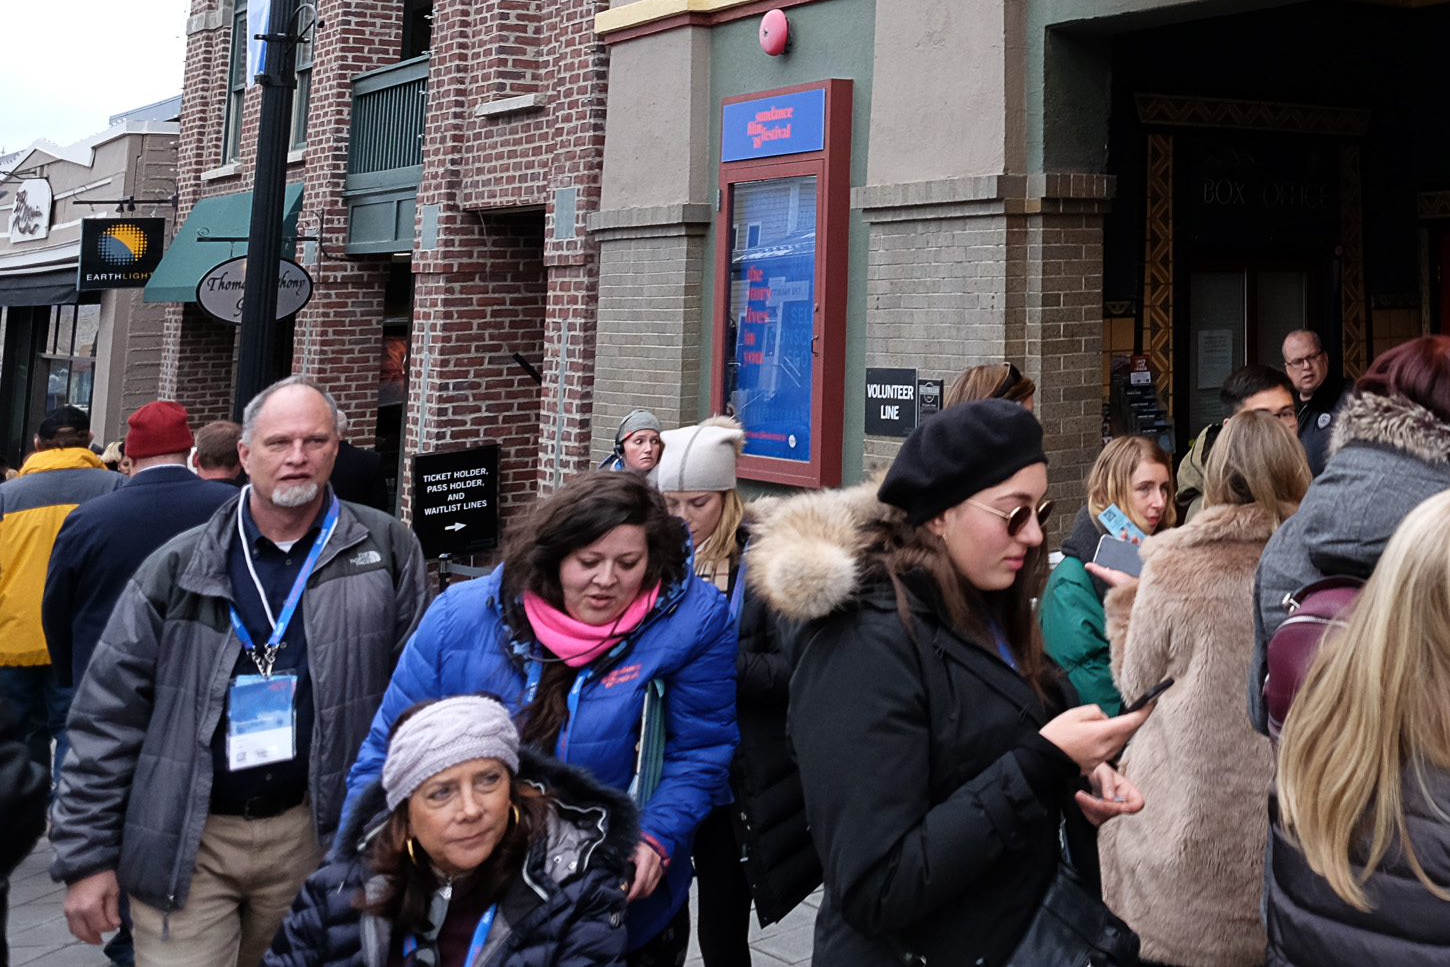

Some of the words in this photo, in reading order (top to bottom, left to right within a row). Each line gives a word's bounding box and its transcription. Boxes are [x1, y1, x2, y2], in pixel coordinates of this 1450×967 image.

[1203, 178, 1246, 205] BOX
[1263, 181, 1328, 209] OFFICE
[747, 265, 764, 282] the
[206, 271, 246, 292] Thoma
[278, 269, 306, 296] hony
[746, 287, 772, 304] story
[745, 306, 769, 323] lives
[744, 329, 755, 346] in
[743, 351, 763, 367] you
[867, 383, 914, 400] VOLUNTEER
[880, 405, 900, 420] LINE
[423, 472, 452, 483] TICKET
[453, 467, 489, 479] HOLDER,
[426, 483, 448, 494] PASS
[449, 478, 485, 490] HOLDER,
[447, 492, 466, 502] AND
[424, 503, 461, 516] WAITLIST
[463, 499, 488, 510] LINES
